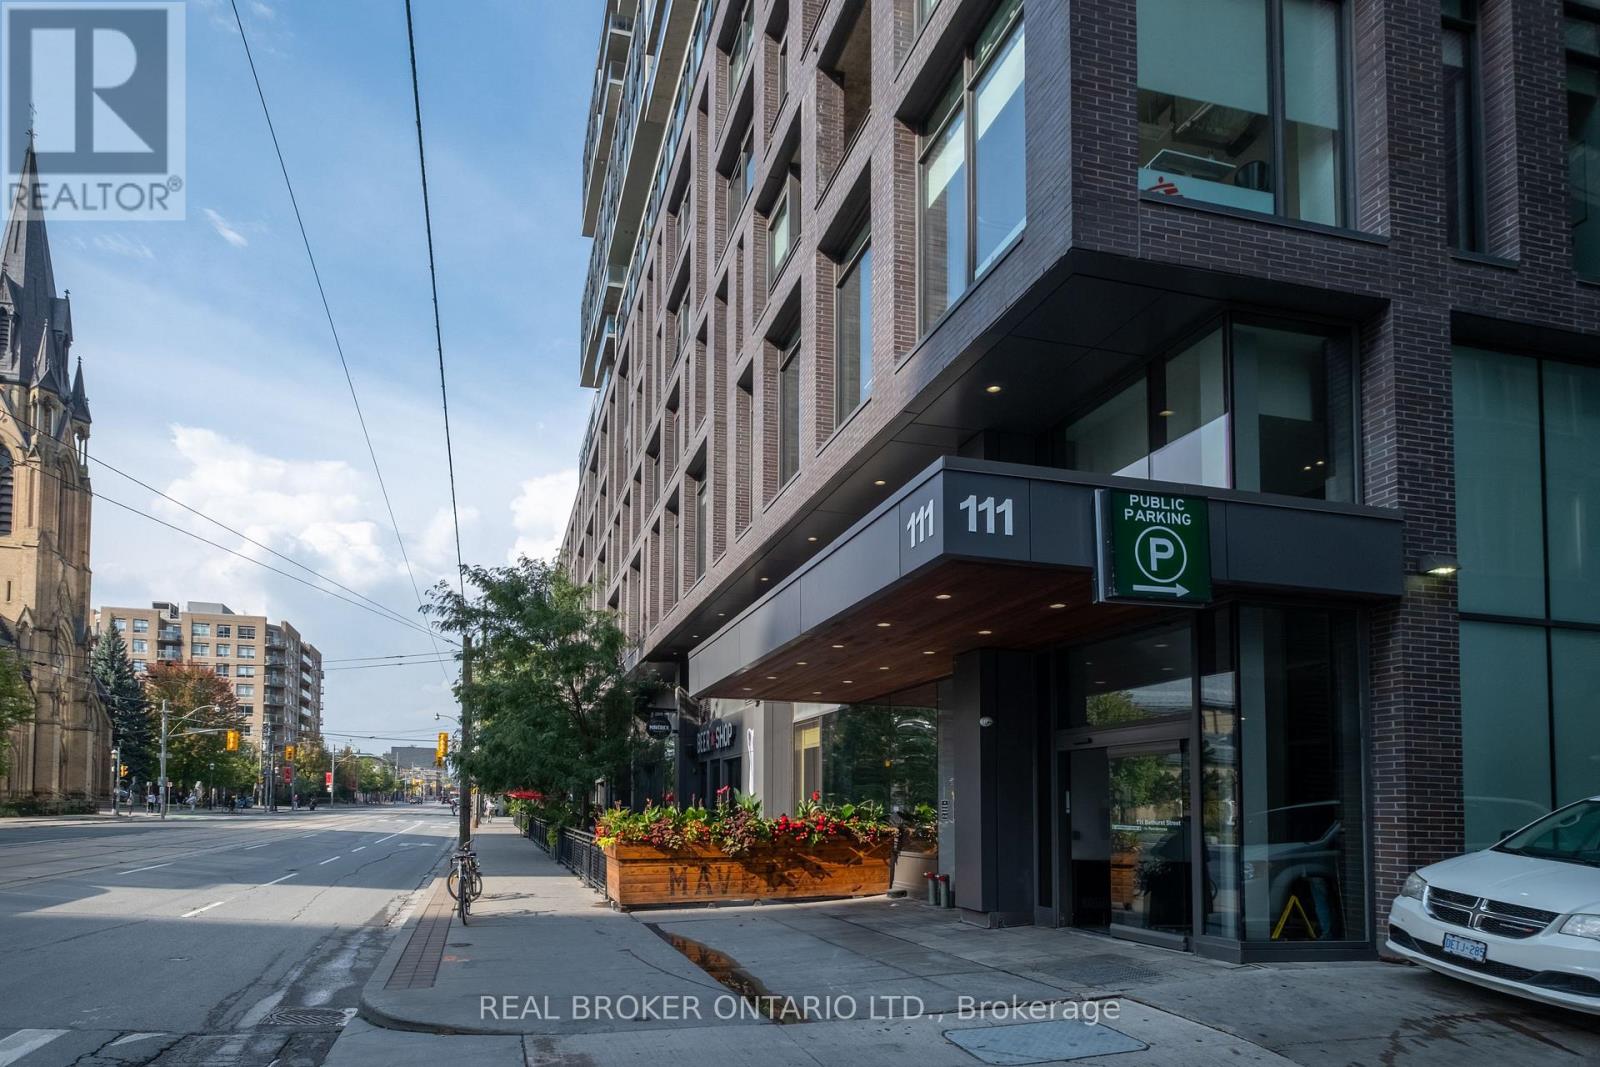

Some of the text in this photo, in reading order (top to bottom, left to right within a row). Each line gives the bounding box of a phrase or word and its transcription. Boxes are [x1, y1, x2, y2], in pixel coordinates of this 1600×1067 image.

[959, 494, 1014, 536] 111
[1124, 508, 1192, 526] PARKING
[1129, 494, 1185, 511] PUBLIC
[906, 499, 934, 549] 111
[1149, 537, 1175, 571] P
[697, 721, 733, 754] BEER SHOP
